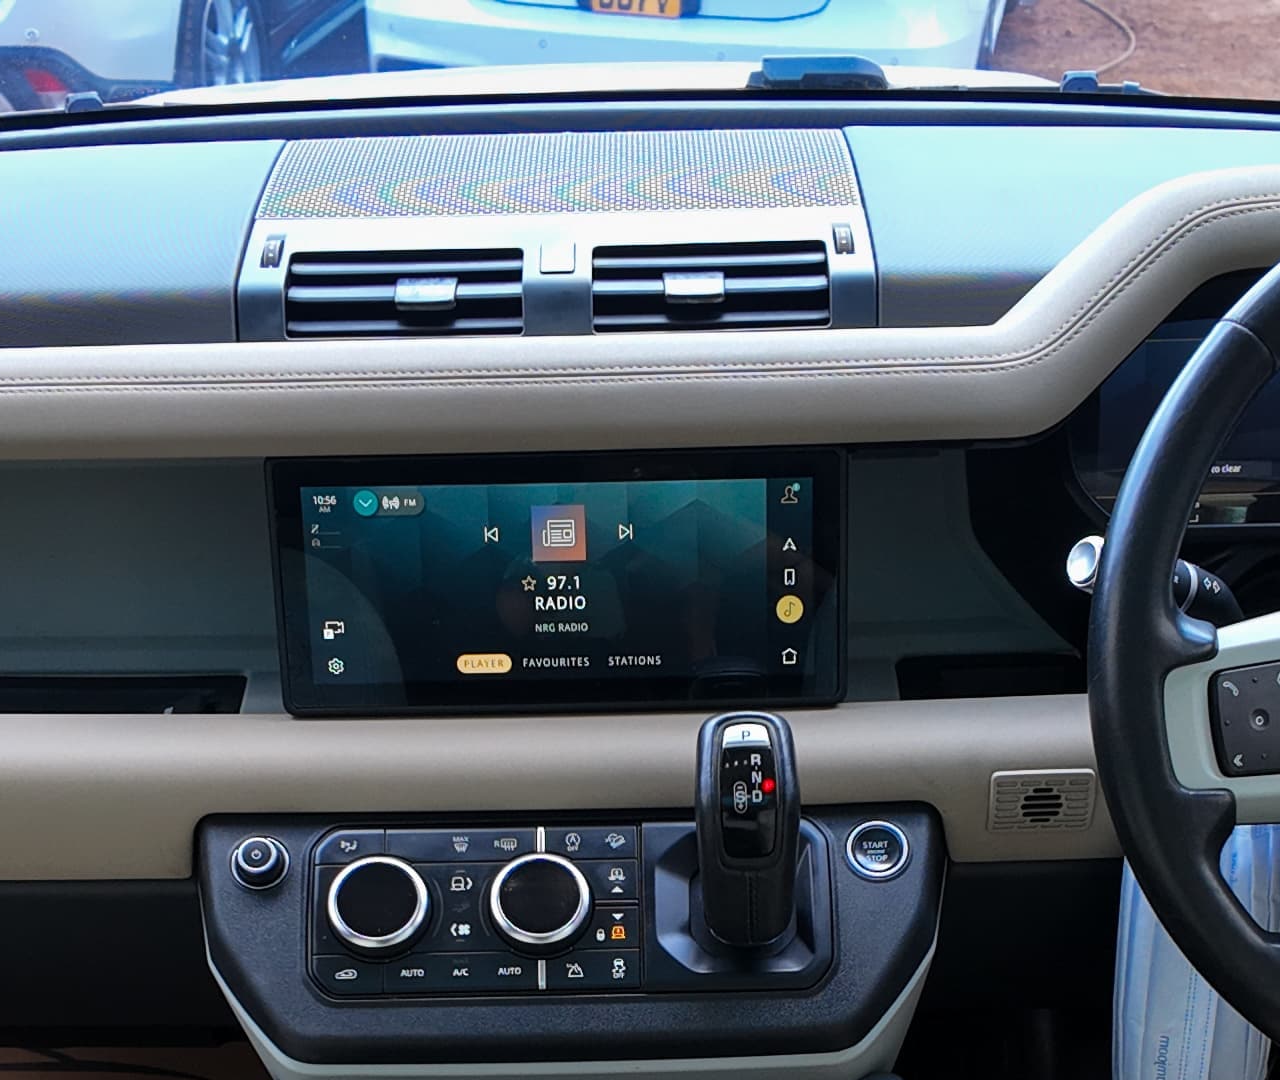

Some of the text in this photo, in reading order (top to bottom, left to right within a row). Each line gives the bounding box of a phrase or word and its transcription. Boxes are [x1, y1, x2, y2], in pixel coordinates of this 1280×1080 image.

[312, 496, 337, 505] 10:56
[403, 498, 416, 507] FM
[547, 575, 580, 590] 97.1
[535, 596, 586, 611] RADIO
[535, 622, 589, 633] NRG RADIO
[463, 658, 505, 669] PLAYER
[522, 656, 590, 668] FAVOURITES
[608, 655, 662, 667] STATIONS
[742, 730, 751, 740] P
[751, 754, 761, 765] R
[752, 771, 762, 783] N
[736, 790, 746, 802] S
[752, 790, 762, 802] D
[862, 841, 888, 849] START
[866, 854, 888, 862] STOP
[400, 969, 425, 978] AUTO
[452, 968, 469, 978] A/C
[497, 967, 522, 976] AUTO
